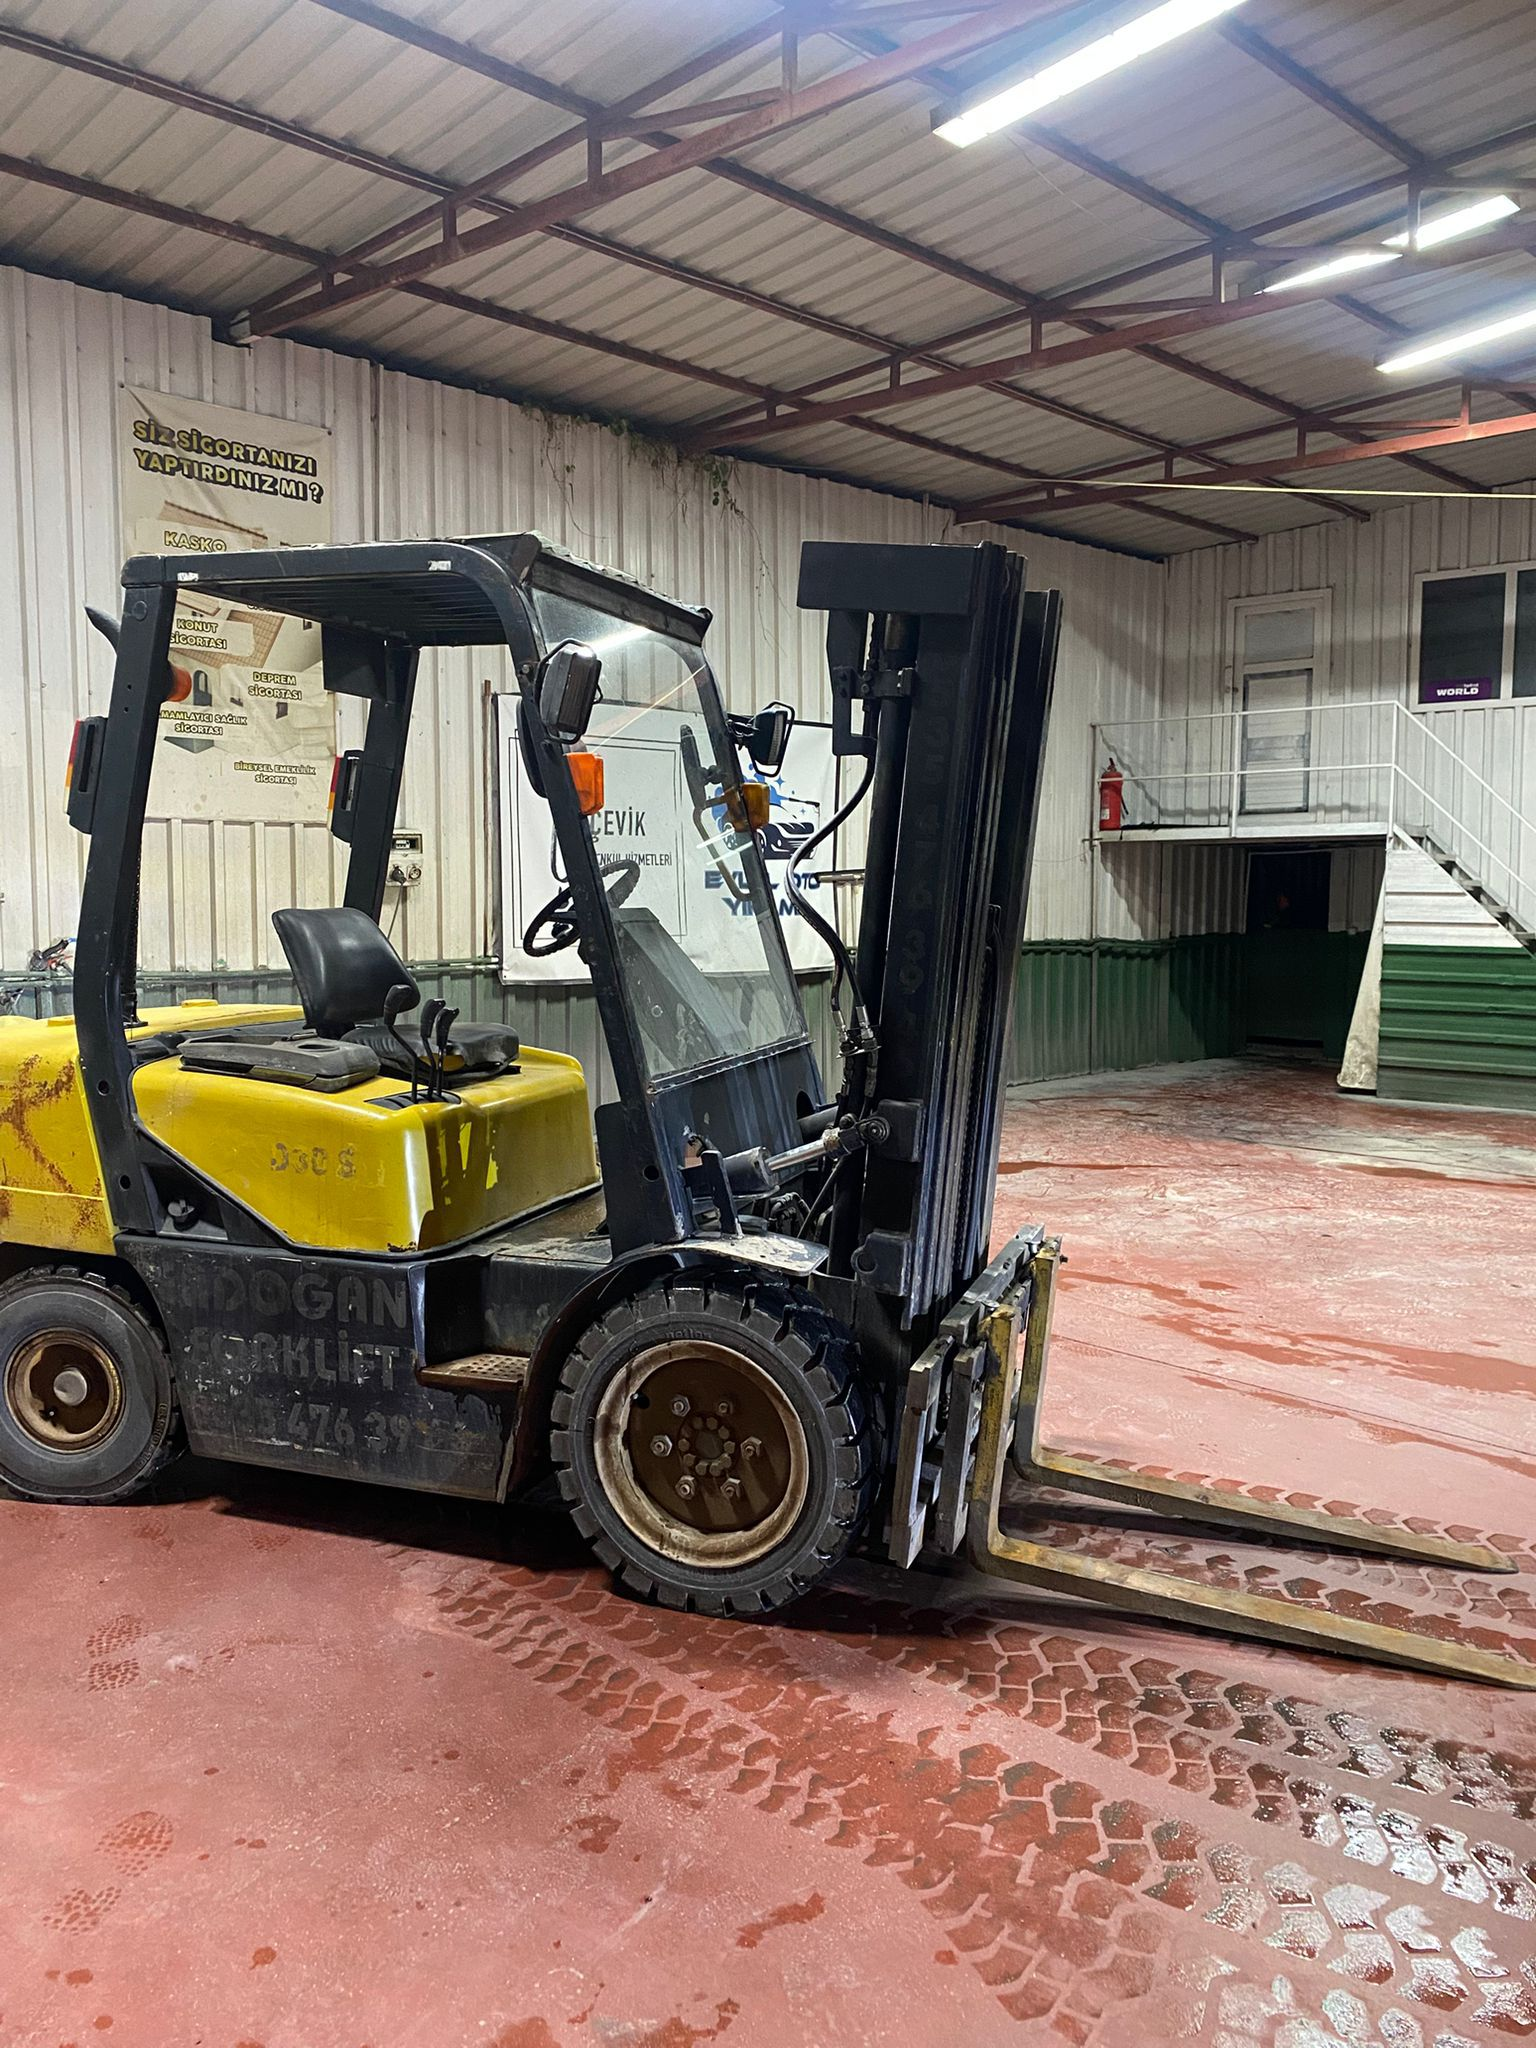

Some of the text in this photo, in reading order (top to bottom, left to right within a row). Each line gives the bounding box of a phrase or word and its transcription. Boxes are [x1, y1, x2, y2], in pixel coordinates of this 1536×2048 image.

[133, 419, 318, 477] SİZ SİGORTANIZI
[133, 448, 279, 496] YAPTIRDINIZ
[164, 531, 227, 552] KASKO
[176, 618, 218, 633] KONUT
[253, 671, 297, 686] DEPREM
[248, 684, 302, 700] SİGORTASI
[1436, 687, 1479, 696] WORLD
[159, 710, 213, 723] MAMLAYICI
[175, 723, 223, 735] SİGORTASI
[234, 761, 316, 775] BİREYSEL EMEKLİLİK
[255, 774, 297, 785] SİGORTASI
